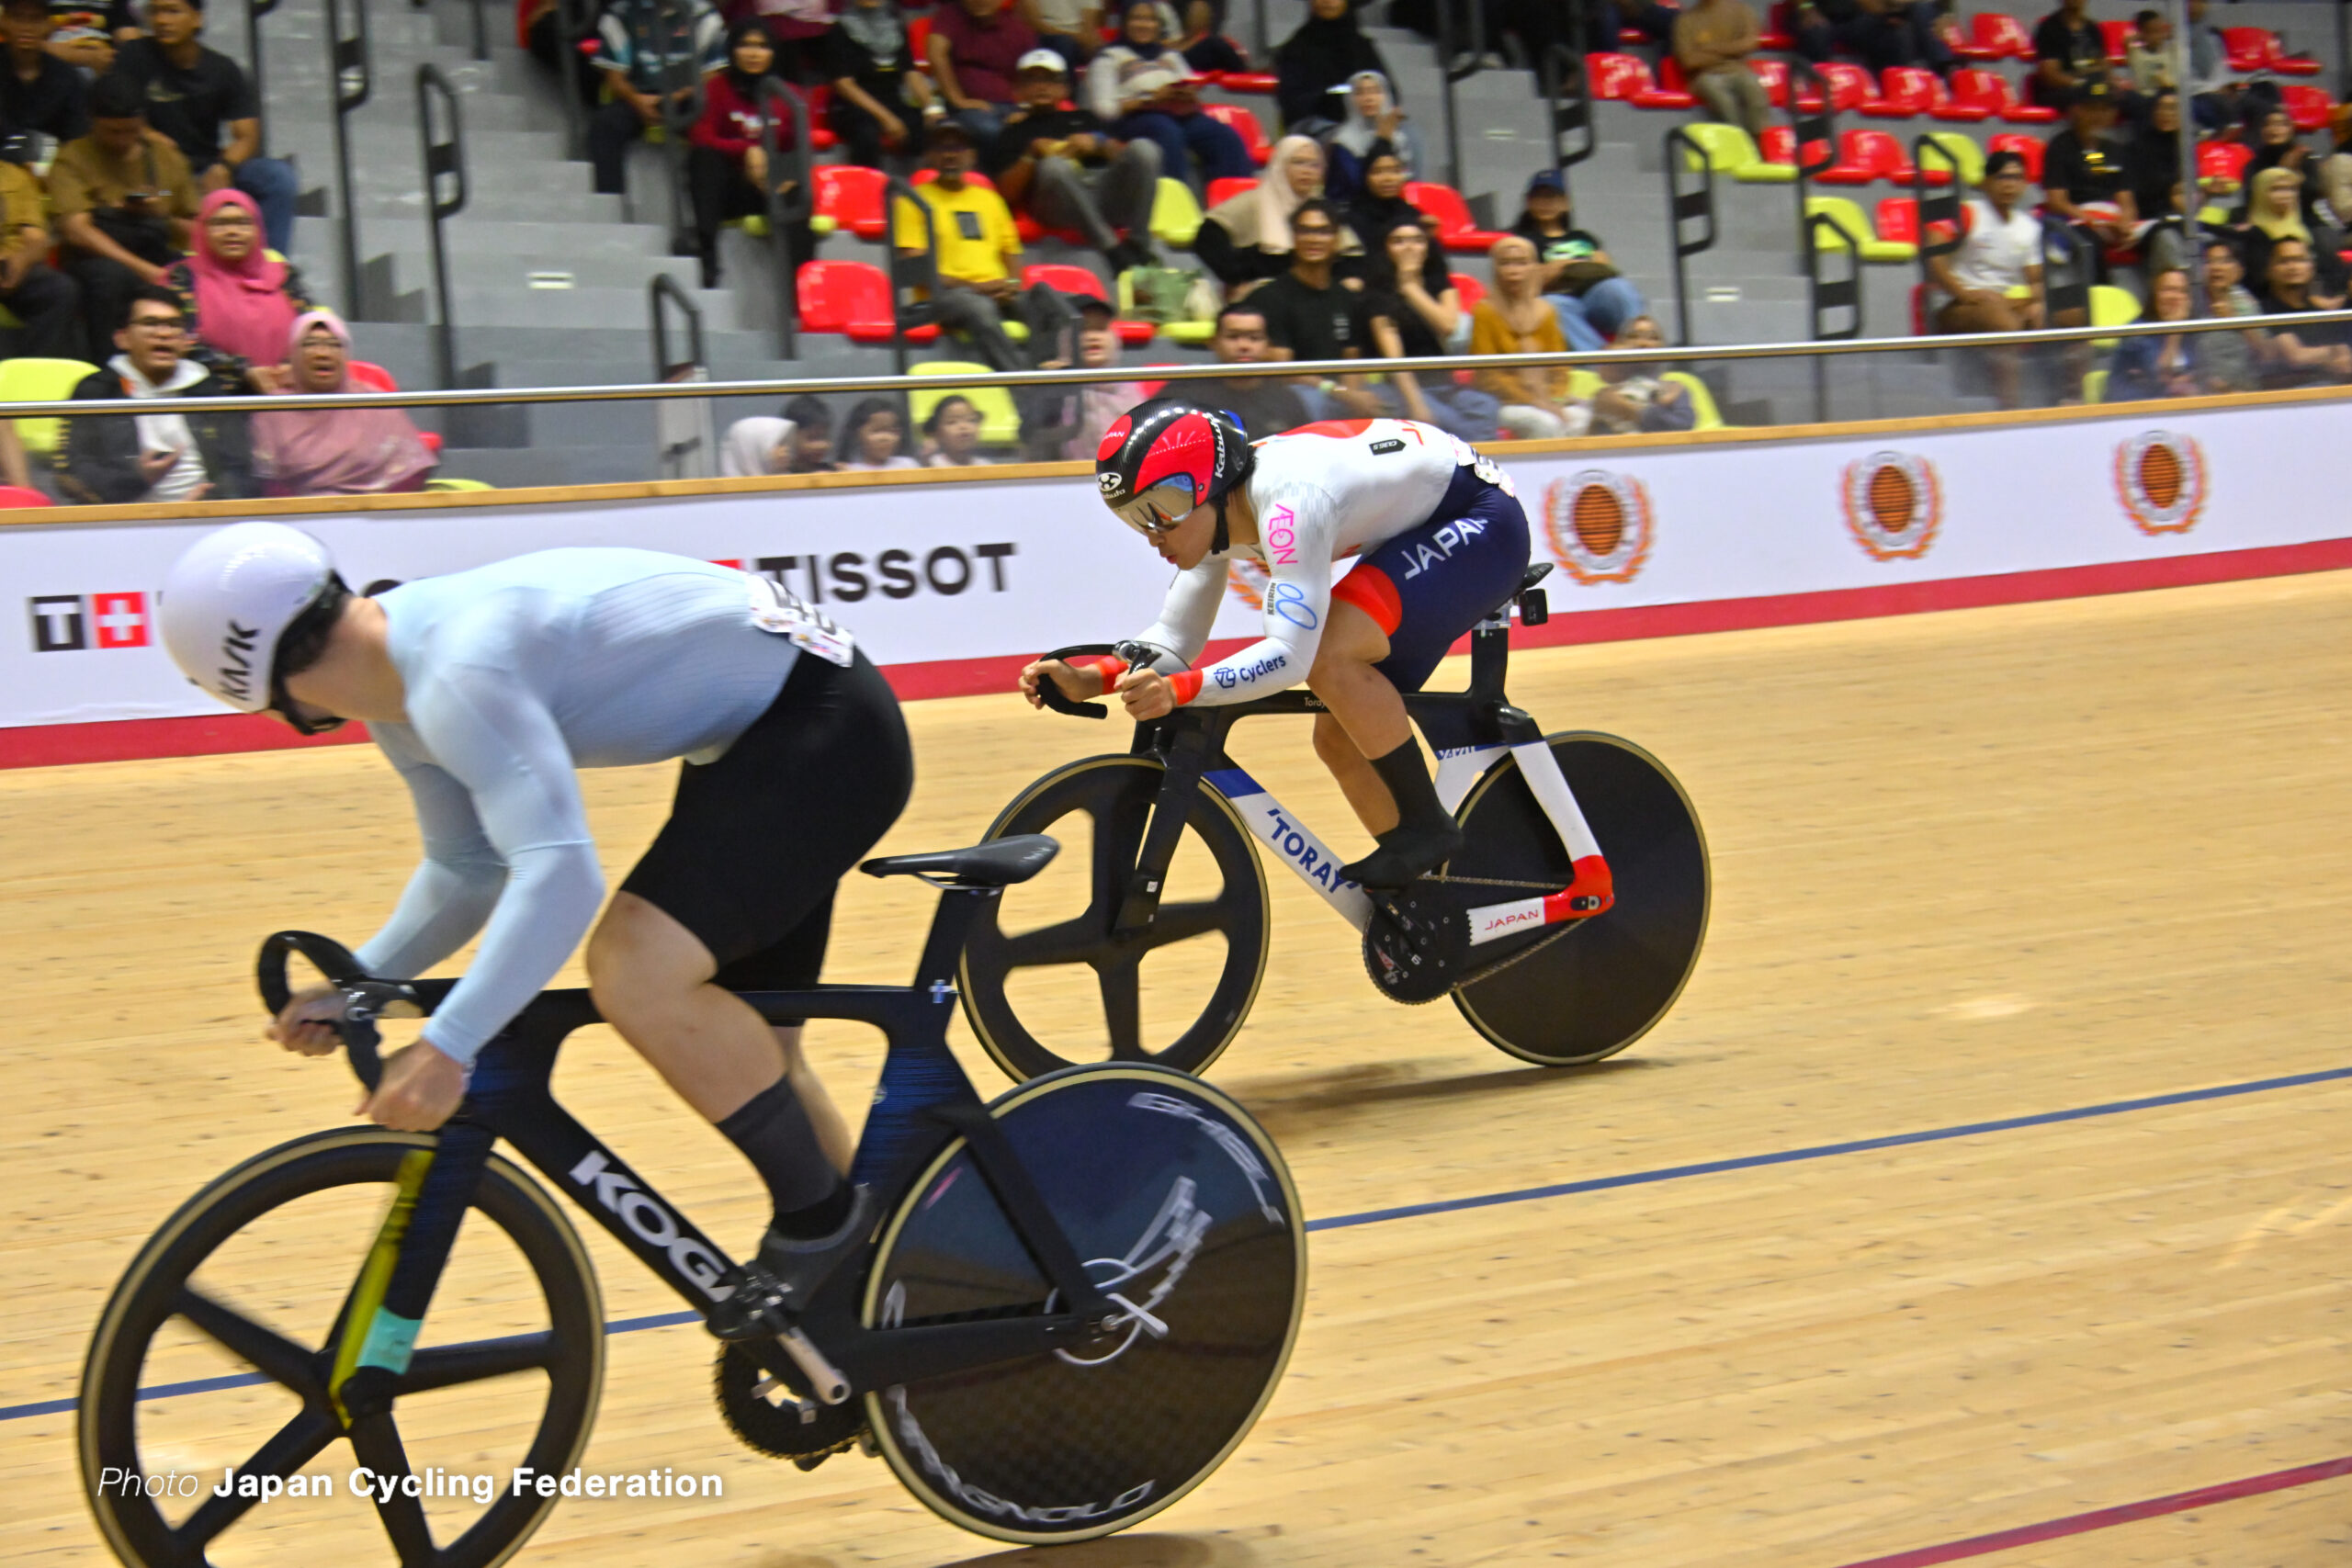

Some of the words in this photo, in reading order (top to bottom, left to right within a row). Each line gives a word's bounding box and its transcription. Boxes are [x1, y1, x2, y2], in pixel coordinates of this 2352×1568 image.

[755, 541, 1018, 604] TISSOT
[1239, 655, 1286, 682] Cyclers
[1485, 909, 1539, 931] JAPAN
